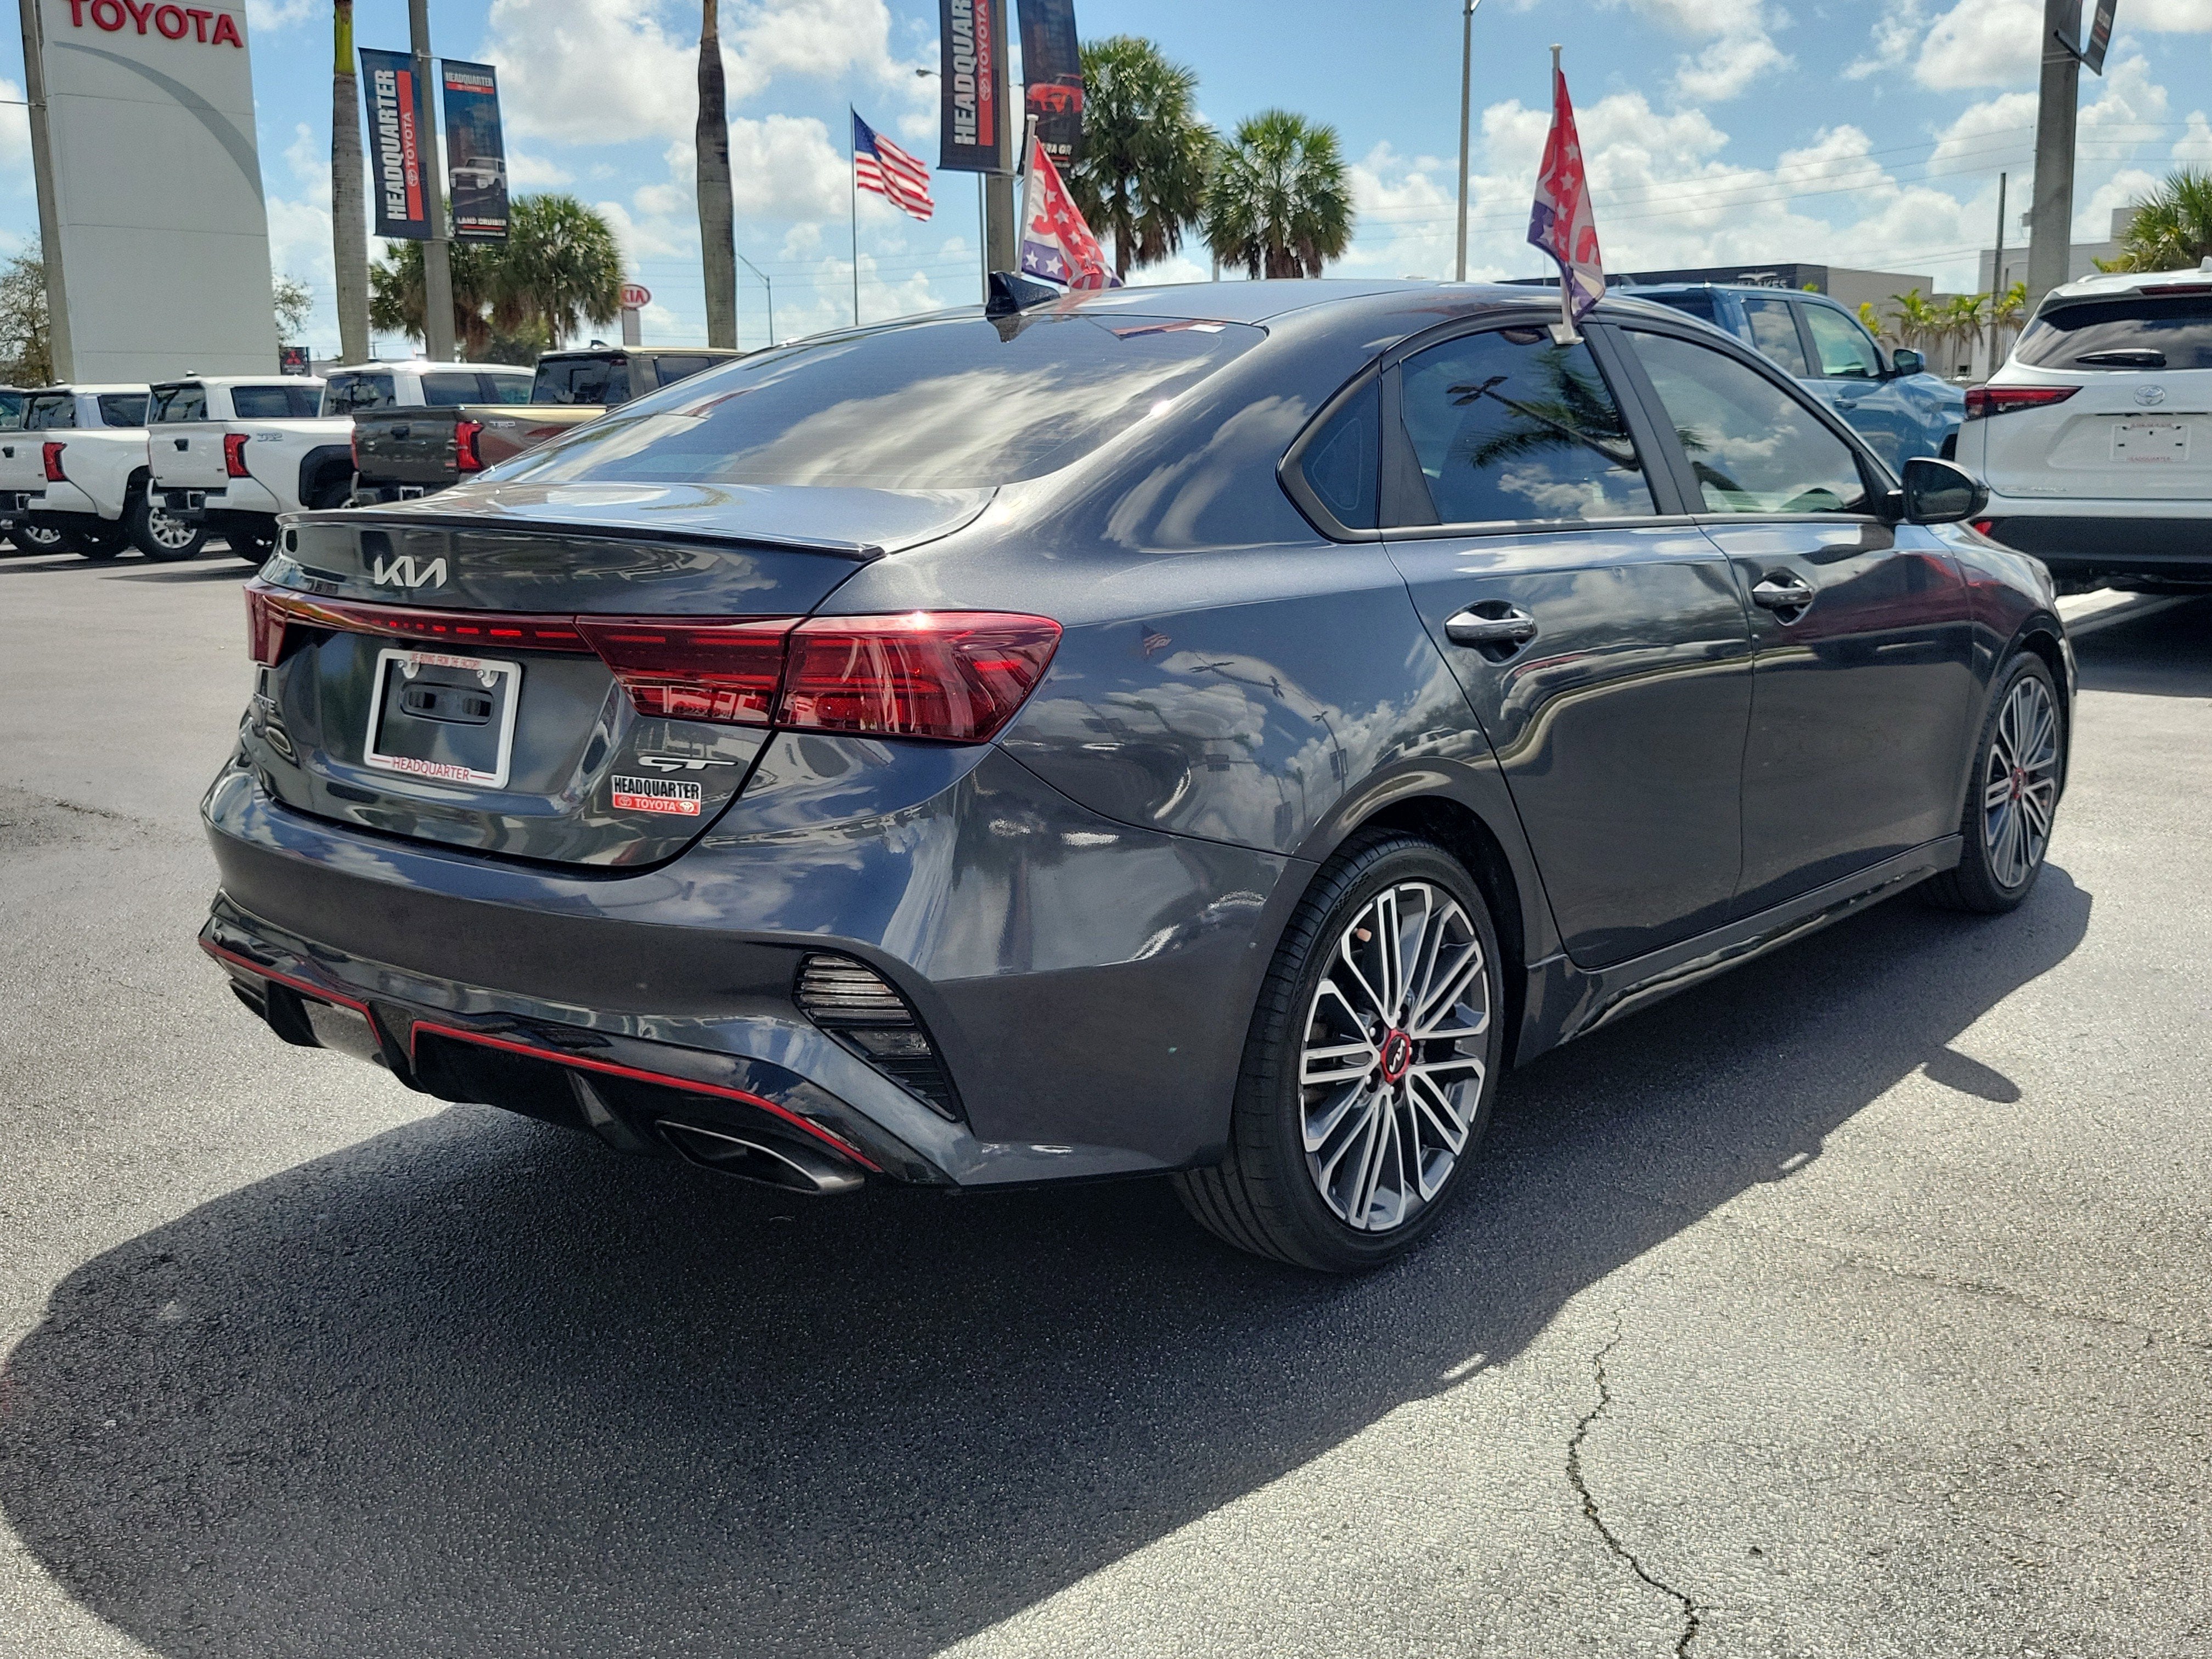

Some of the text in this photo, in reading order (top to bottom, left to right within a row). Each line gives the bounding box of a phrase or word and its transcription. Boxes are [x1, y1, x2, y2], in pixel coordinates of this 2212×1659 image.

[69, 0, 244, 48] TOYOTA
[977, 4, 989, 76] TOYOTA
[952, 0, 977, 145] HEADQUAR
[375, 70, 407, 221] HEADQUARTER
[402, 112, 415, 167] TOYOTA
[477, 218, 506, 226] CRUISER
[374, 555, 448, 589] KIA
[392, 757, 470, 781] HEADQUARTER
[638, 756, 736, 772] GT
[614, 777, 699, 800] HEADQUARTER
[634, 798, 677, 812] TOYOTA
